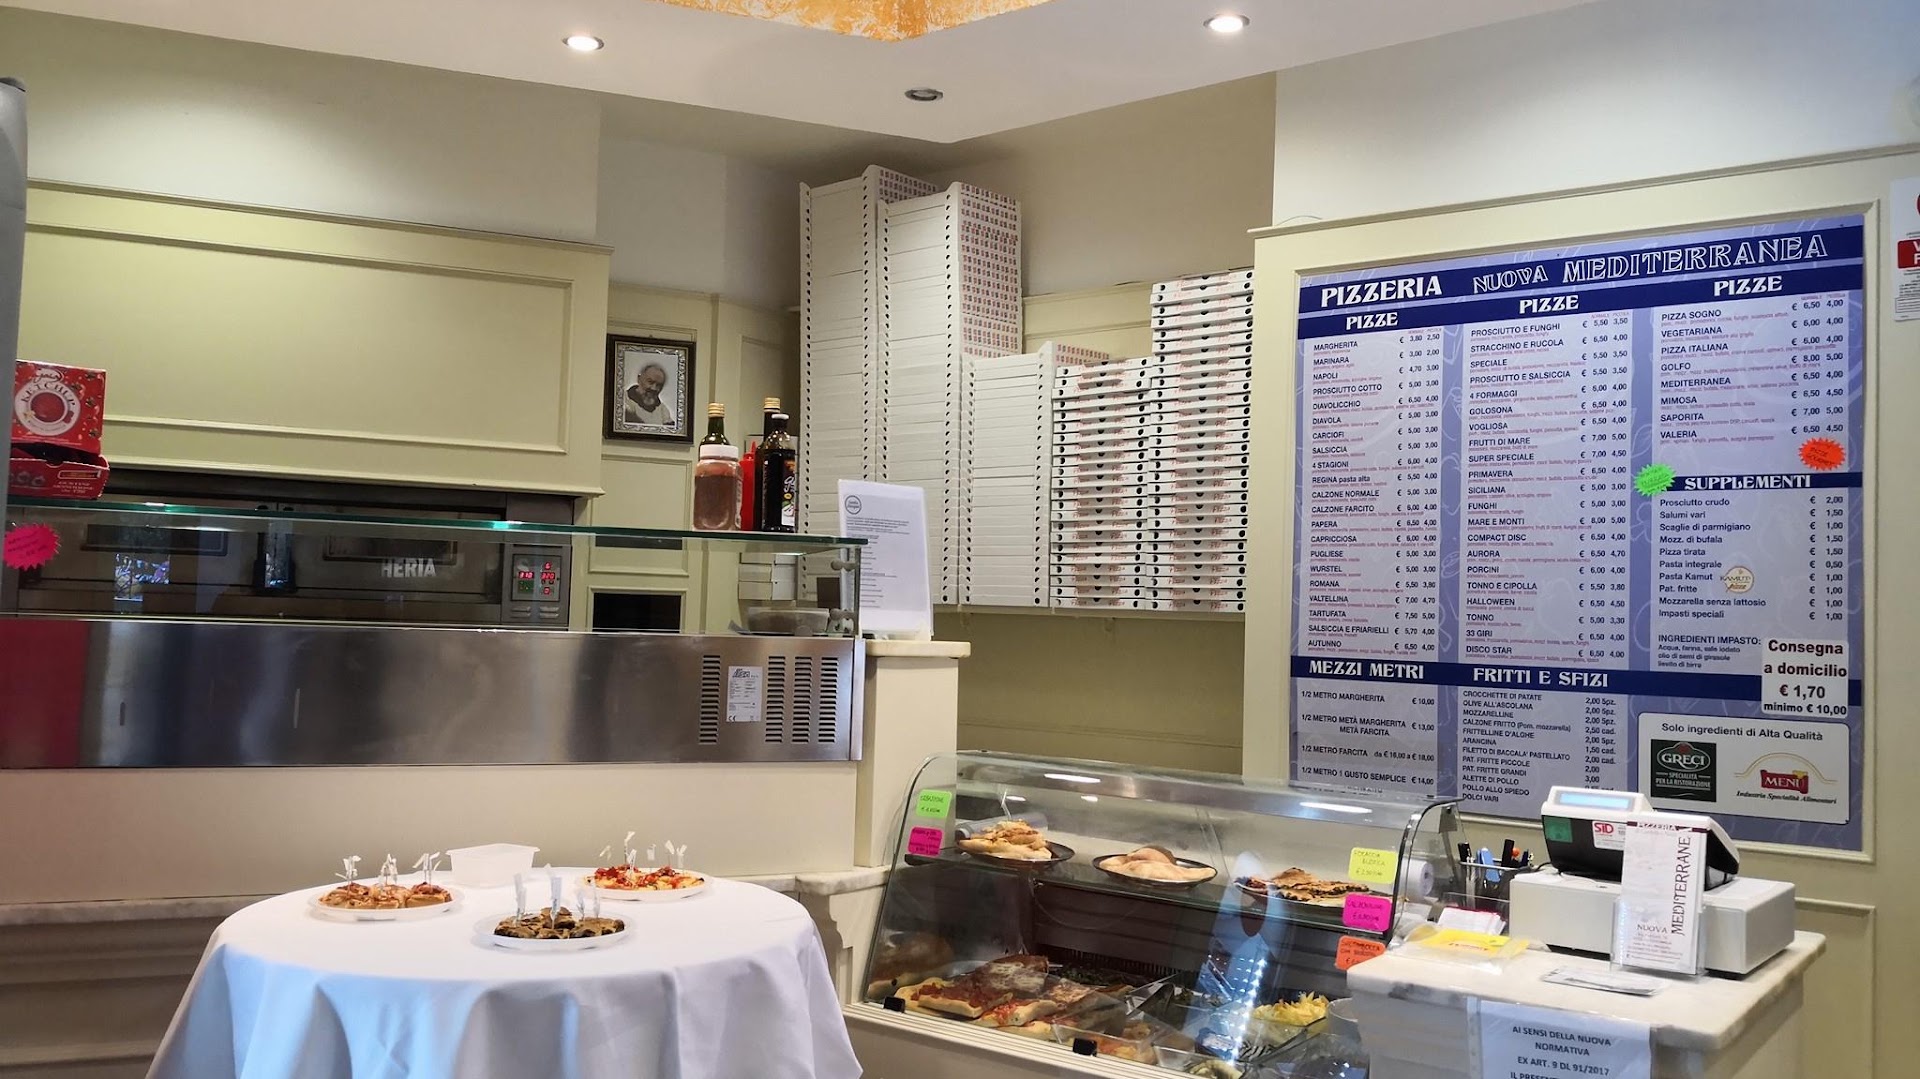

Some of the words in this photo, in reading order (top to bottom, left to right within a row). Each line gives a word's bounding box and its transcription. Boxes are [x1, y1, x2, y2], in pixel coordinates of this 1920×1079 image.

[1321, 276, 1442, 308] PIZZERIA
[1473, 265, 1548, 294] NUOVA
[1562, 234, 1828, 283] MEDITERRANEA
[1714, 276, 1782, 296] PIZZE
[1519, 294, 1578, 313] PIZZE
[1689, 310, 1721, 318] SOGNO
[1346, 312, 1398, 330] PIZZE
[1471, 326, 1520, 337] PROSCIUTTO
[1662, 327, 1722, 338] VEGETARIANA
[1314, 341, 1358, 350] MARGHERITA
[1689, 344, 1728, 352] ITALIANA
[1470, 359, 1507, 368] SPECIALE
[1661, 362, 1690, 371] GOLFO
[1661, 378, 1731, 388] MEDITERRANEA
[1313, 386, 1356, 396] PROSCIUTTO
[1358, 384, 1382, 392] COTTO
[1313, 401, 1360, 410] DIAVOLICCHIO
[1661, 413, 1704, 421] SAPORITA
[1684, 474, 1811, 490] SUPPLEMENTI
[1660, 524, 1690, 532] Scaglie
[1702, 524, 1750, 532] parmigiano
[382, 558, 436, 578] HERIA
[1686, 561, 1722, 569] integrale
[1692, 610, 1724, 618] speciali
[1659, 635, 1714, 643] INGREDIENTI
[1769, 640, 1843, 656] Consegna
[1310, 661, 1361, 675] MEZZI
[1370, 664, 1423, 678] METRI
[1764, 665, 1772, 673] a
[1778, 663, 1847, 676] domicilio
[1474, 668, 1530, 683] FRITTI
[1539, 671, 1550, 684] E
[1559, 672, 1607, 687] SFIZI
[1339, 694, 1385, 702] MARGHERITA
[1780, 684, 1788, 696] €
[1794, 686, 1825, 700] 1,70
[1463, 710, 1513, 719] MOZZARELLINE
[1763, 702, 1802, 712] minimo
[1806, 704, 1813, 712] €
[1817, 705, 1846, 715] 10,00
[1360, 718, 1406, 728] MARGHERITA
[1662, 723, 1684, 732] Solo
[1688, 727, 1742, 735] ingredienti
[1759, 729, 1780, 738] Alta
[1784, 730, 1822, 740] Qualità
[1662, 752, 1704, 770] GRECI
[1523, 1028, 1547, 1037] SENSI
[1549, 1031, 1575, 1040] DELLA
[1578, 1036, 1611, 1046] NUOVA
[1536, 1041, 1590, 1055] NORMATIVA
[1531, 1058, 1549, 1067] ART.
[1573, 1064, 1609, 1075] 91/2017
